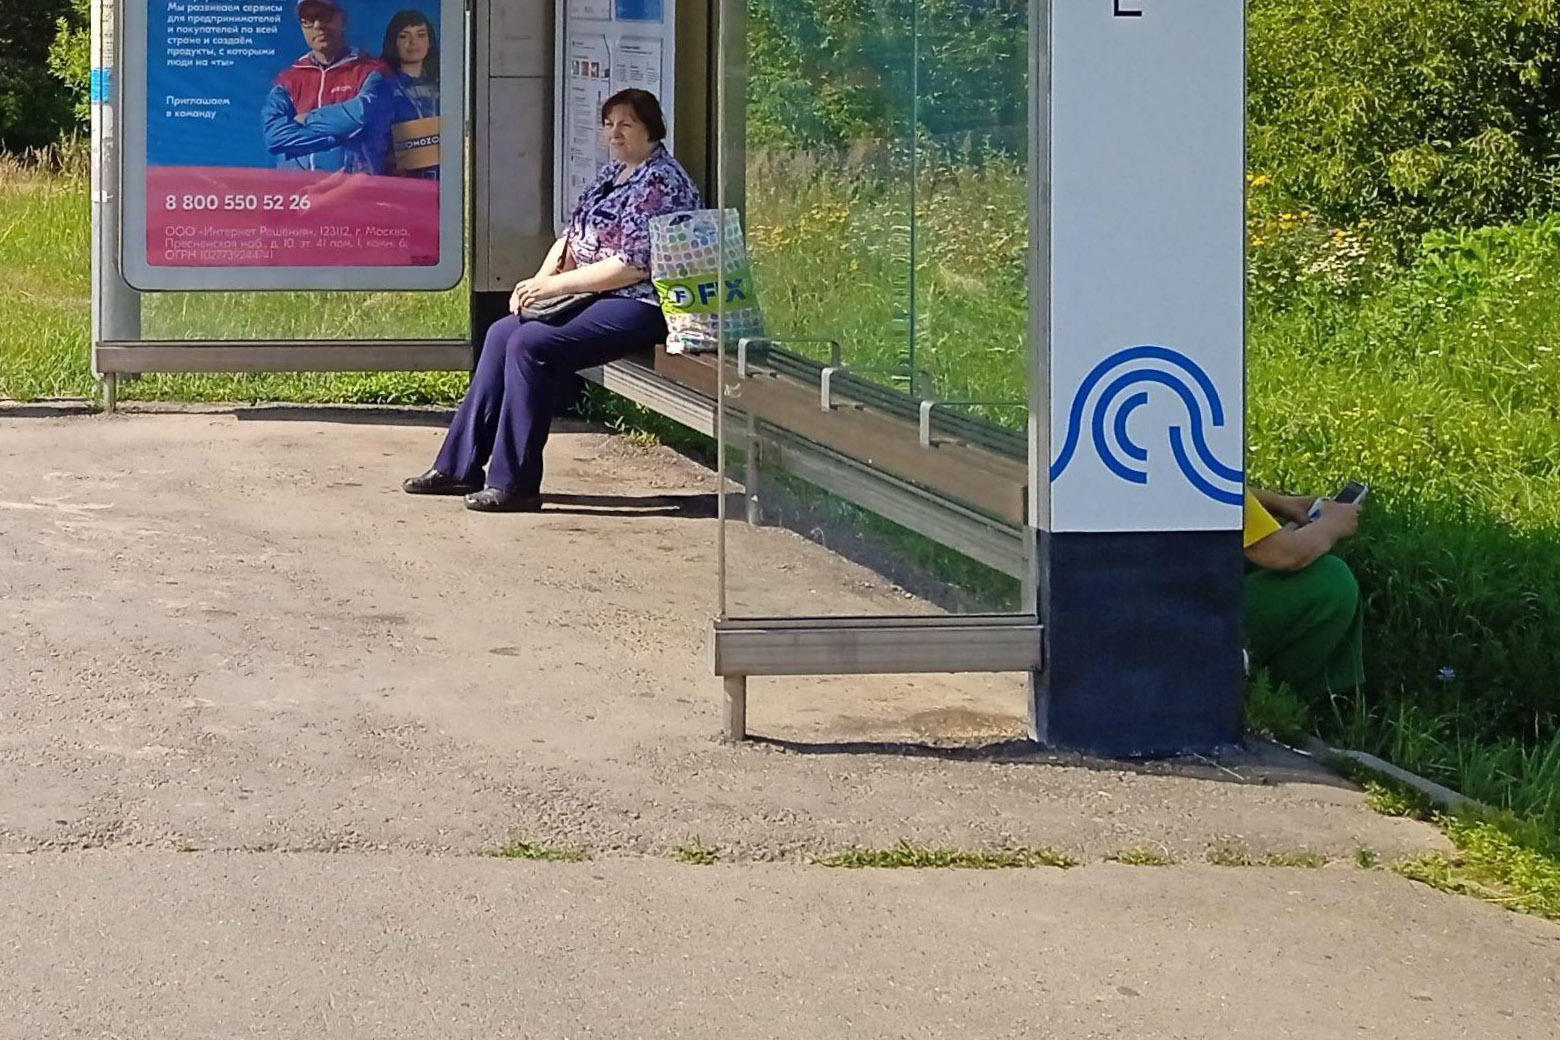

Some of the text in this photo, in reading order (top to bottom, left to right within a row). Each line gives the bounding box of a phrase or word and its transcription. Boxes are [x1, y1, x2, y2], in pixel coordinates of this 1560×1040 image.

[167, 2, 185, 12] Мы
[242, 4, 283, 14] сервисы
[167, 14, 281, 25] для предпринимателей
[176, 25, 239, 36] покупателей
[241, 26, 254, 34] по
[255, 25, 278, 34] всей
[226, 48, 276, 57] которыми
[166, 95, 231, 107] Приглашаем
[166, 110, 217, 120] в команду
[165, 194, 311, 210] 8 800 550 52 26
[165, 225, 196, 237] ООО
